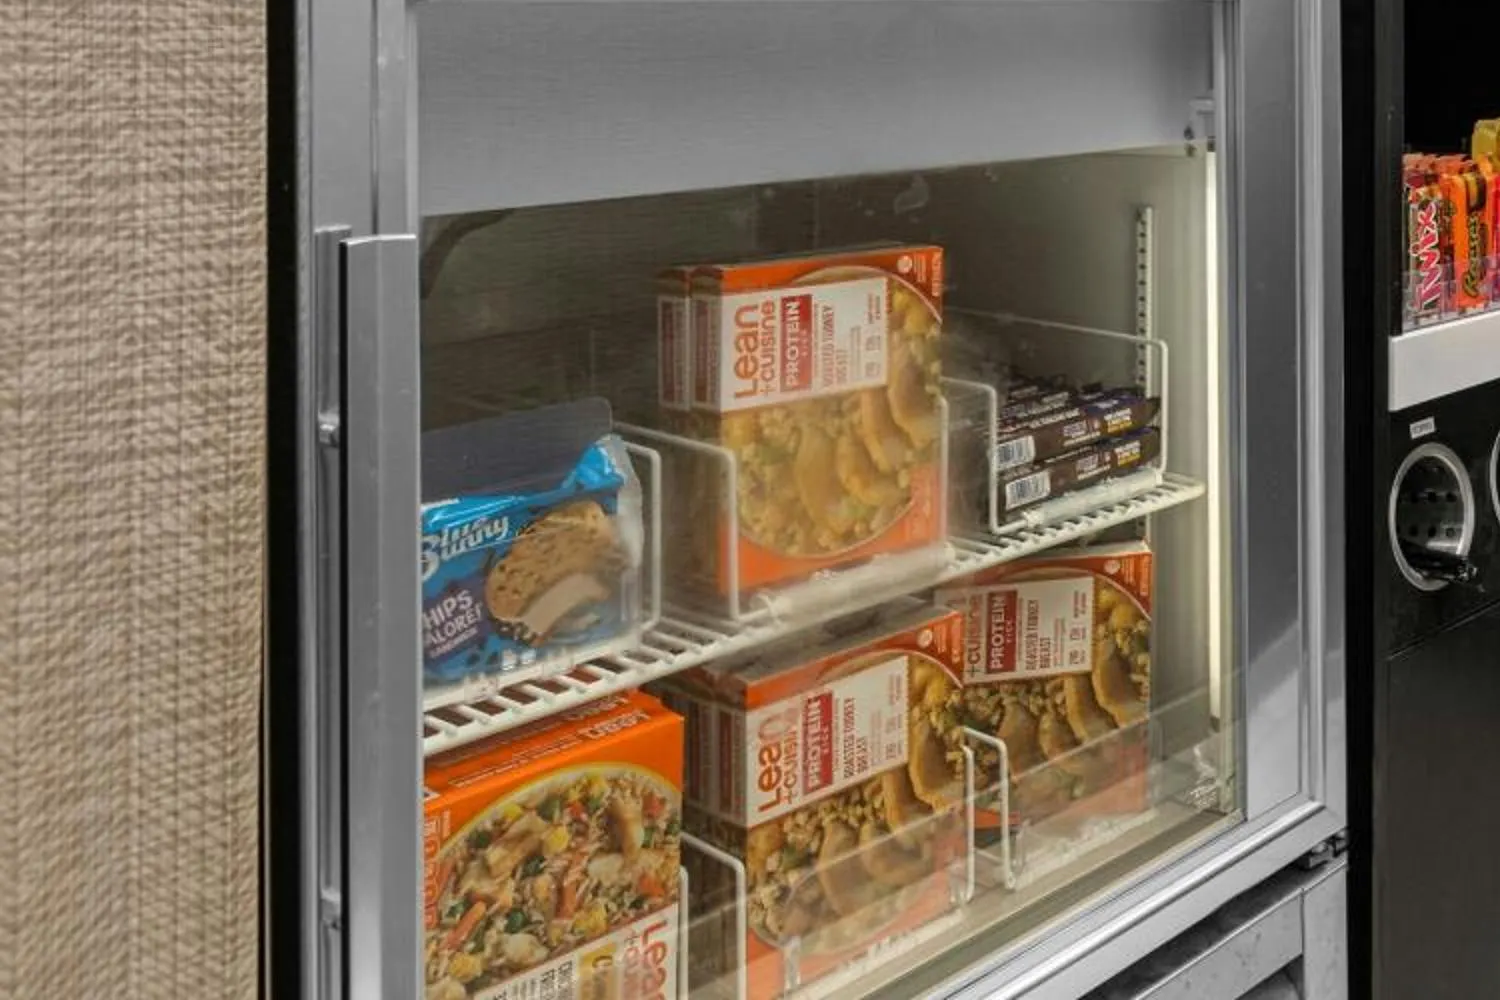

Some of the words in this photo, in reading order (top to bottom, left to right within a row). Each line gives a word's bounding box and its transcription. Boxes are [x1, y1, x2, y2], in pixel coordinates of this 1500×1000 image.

[733, 303, 760, 399] Lean
[784, 297, 801, 387] PROTEIN
[421, 588, 473, 631] HIPS
[991, 596, 1006, 669] PROTEIN
[806, 696, 822, 788] PROTEIN
